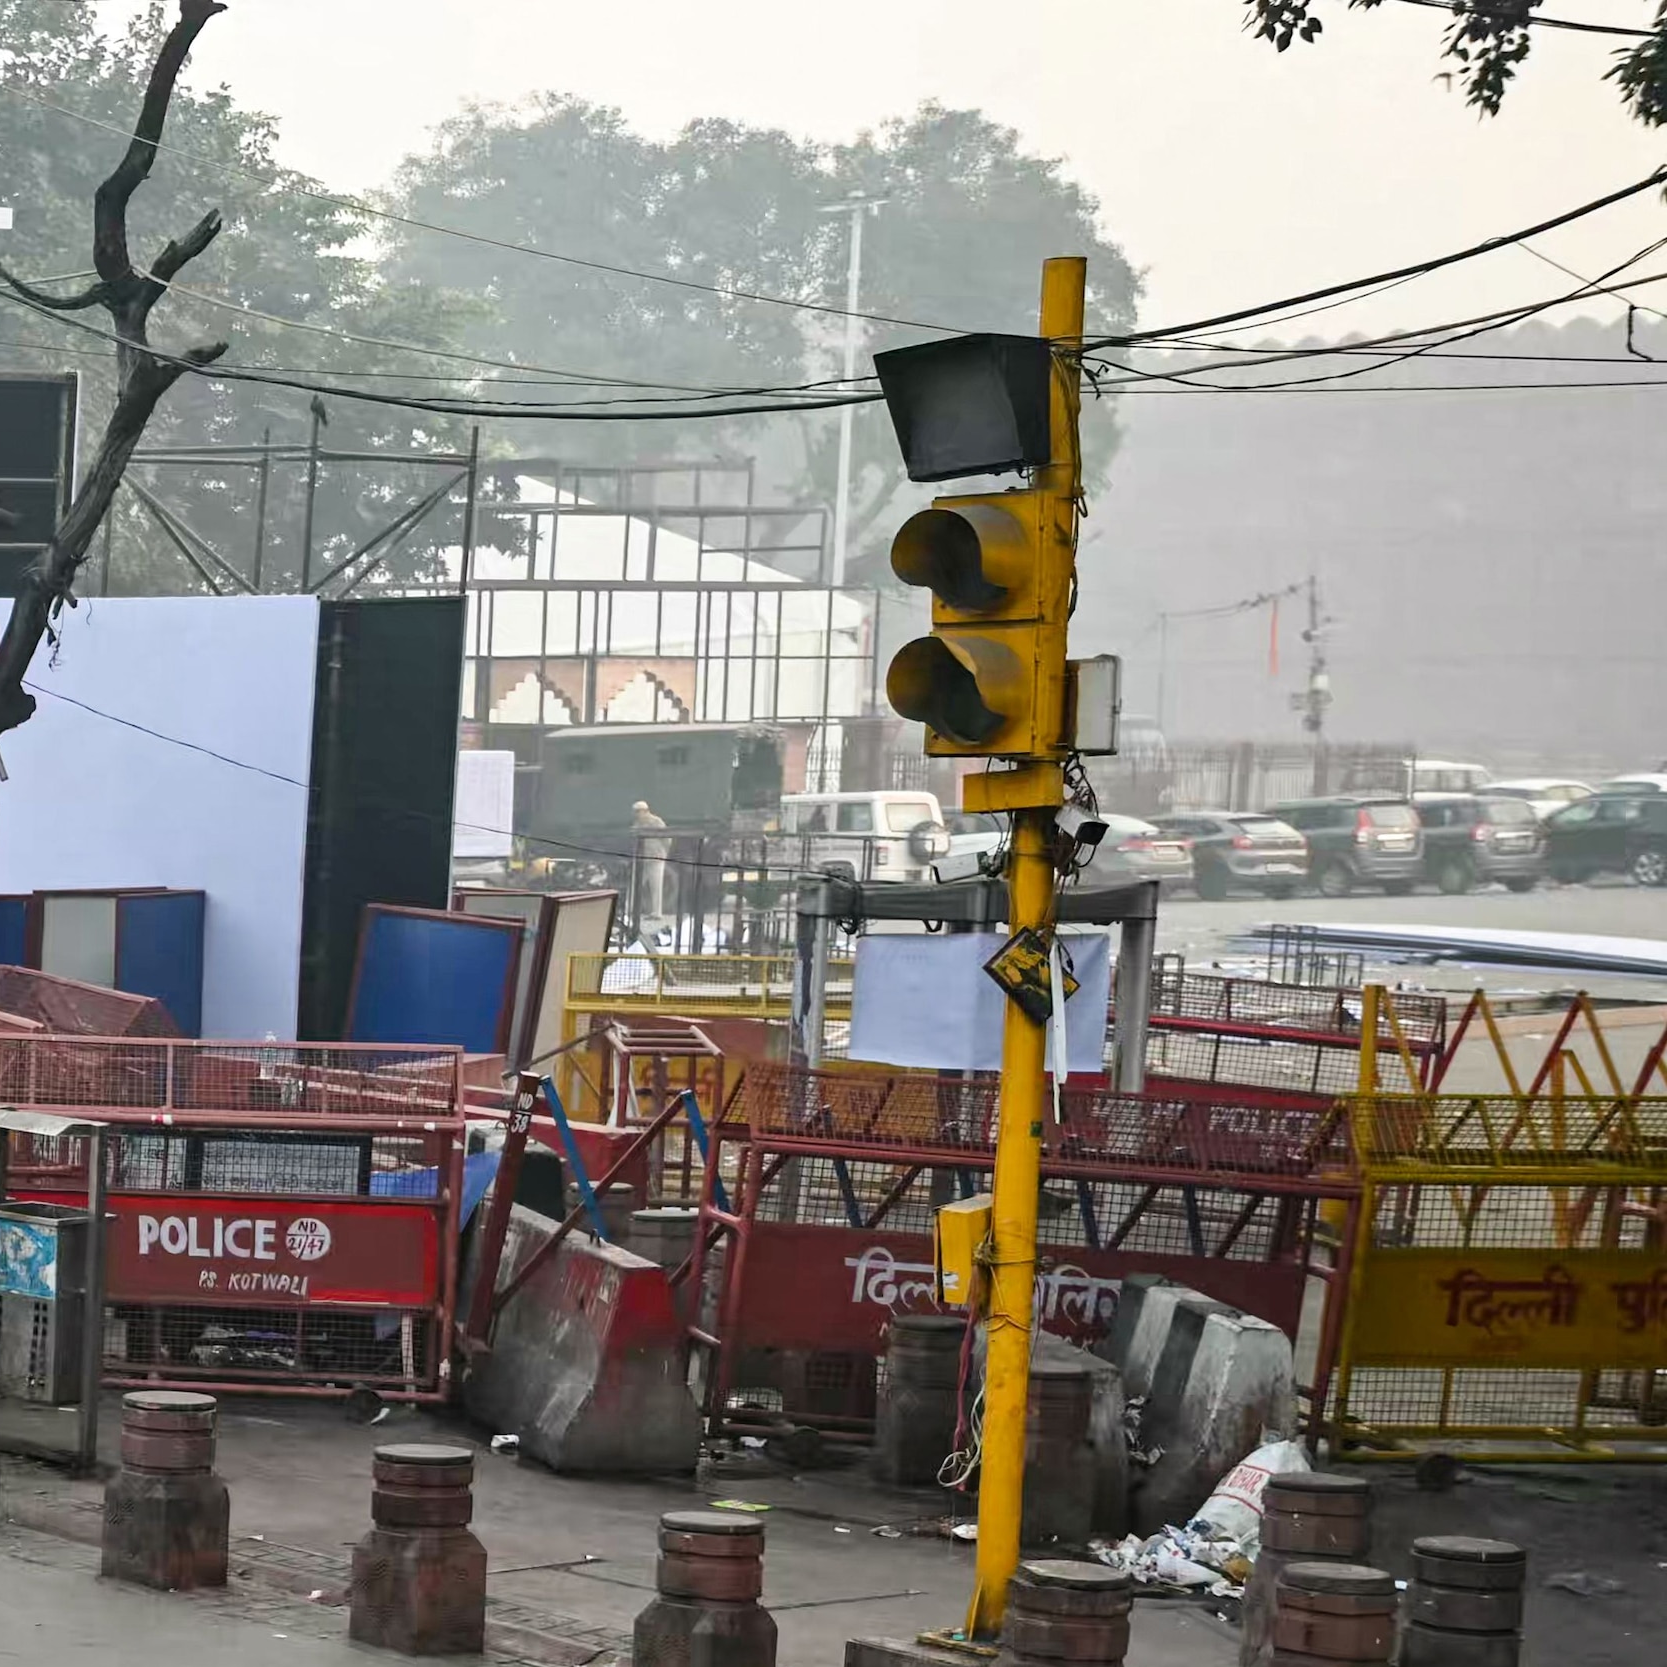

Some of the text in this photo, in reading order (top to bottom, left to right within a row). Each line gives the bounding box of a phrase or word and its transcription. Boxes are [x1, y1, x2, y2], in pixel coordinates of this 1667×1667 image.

[138, 1214, 277, 1261] POLICE
[297, 1220, 318, 1234] ND
[287, 1234, 326, 1258] 21/47
[227, 1272, 309, 1296] KOTWALI
[1436, 1265, 1579, 1337] दिल्ली
